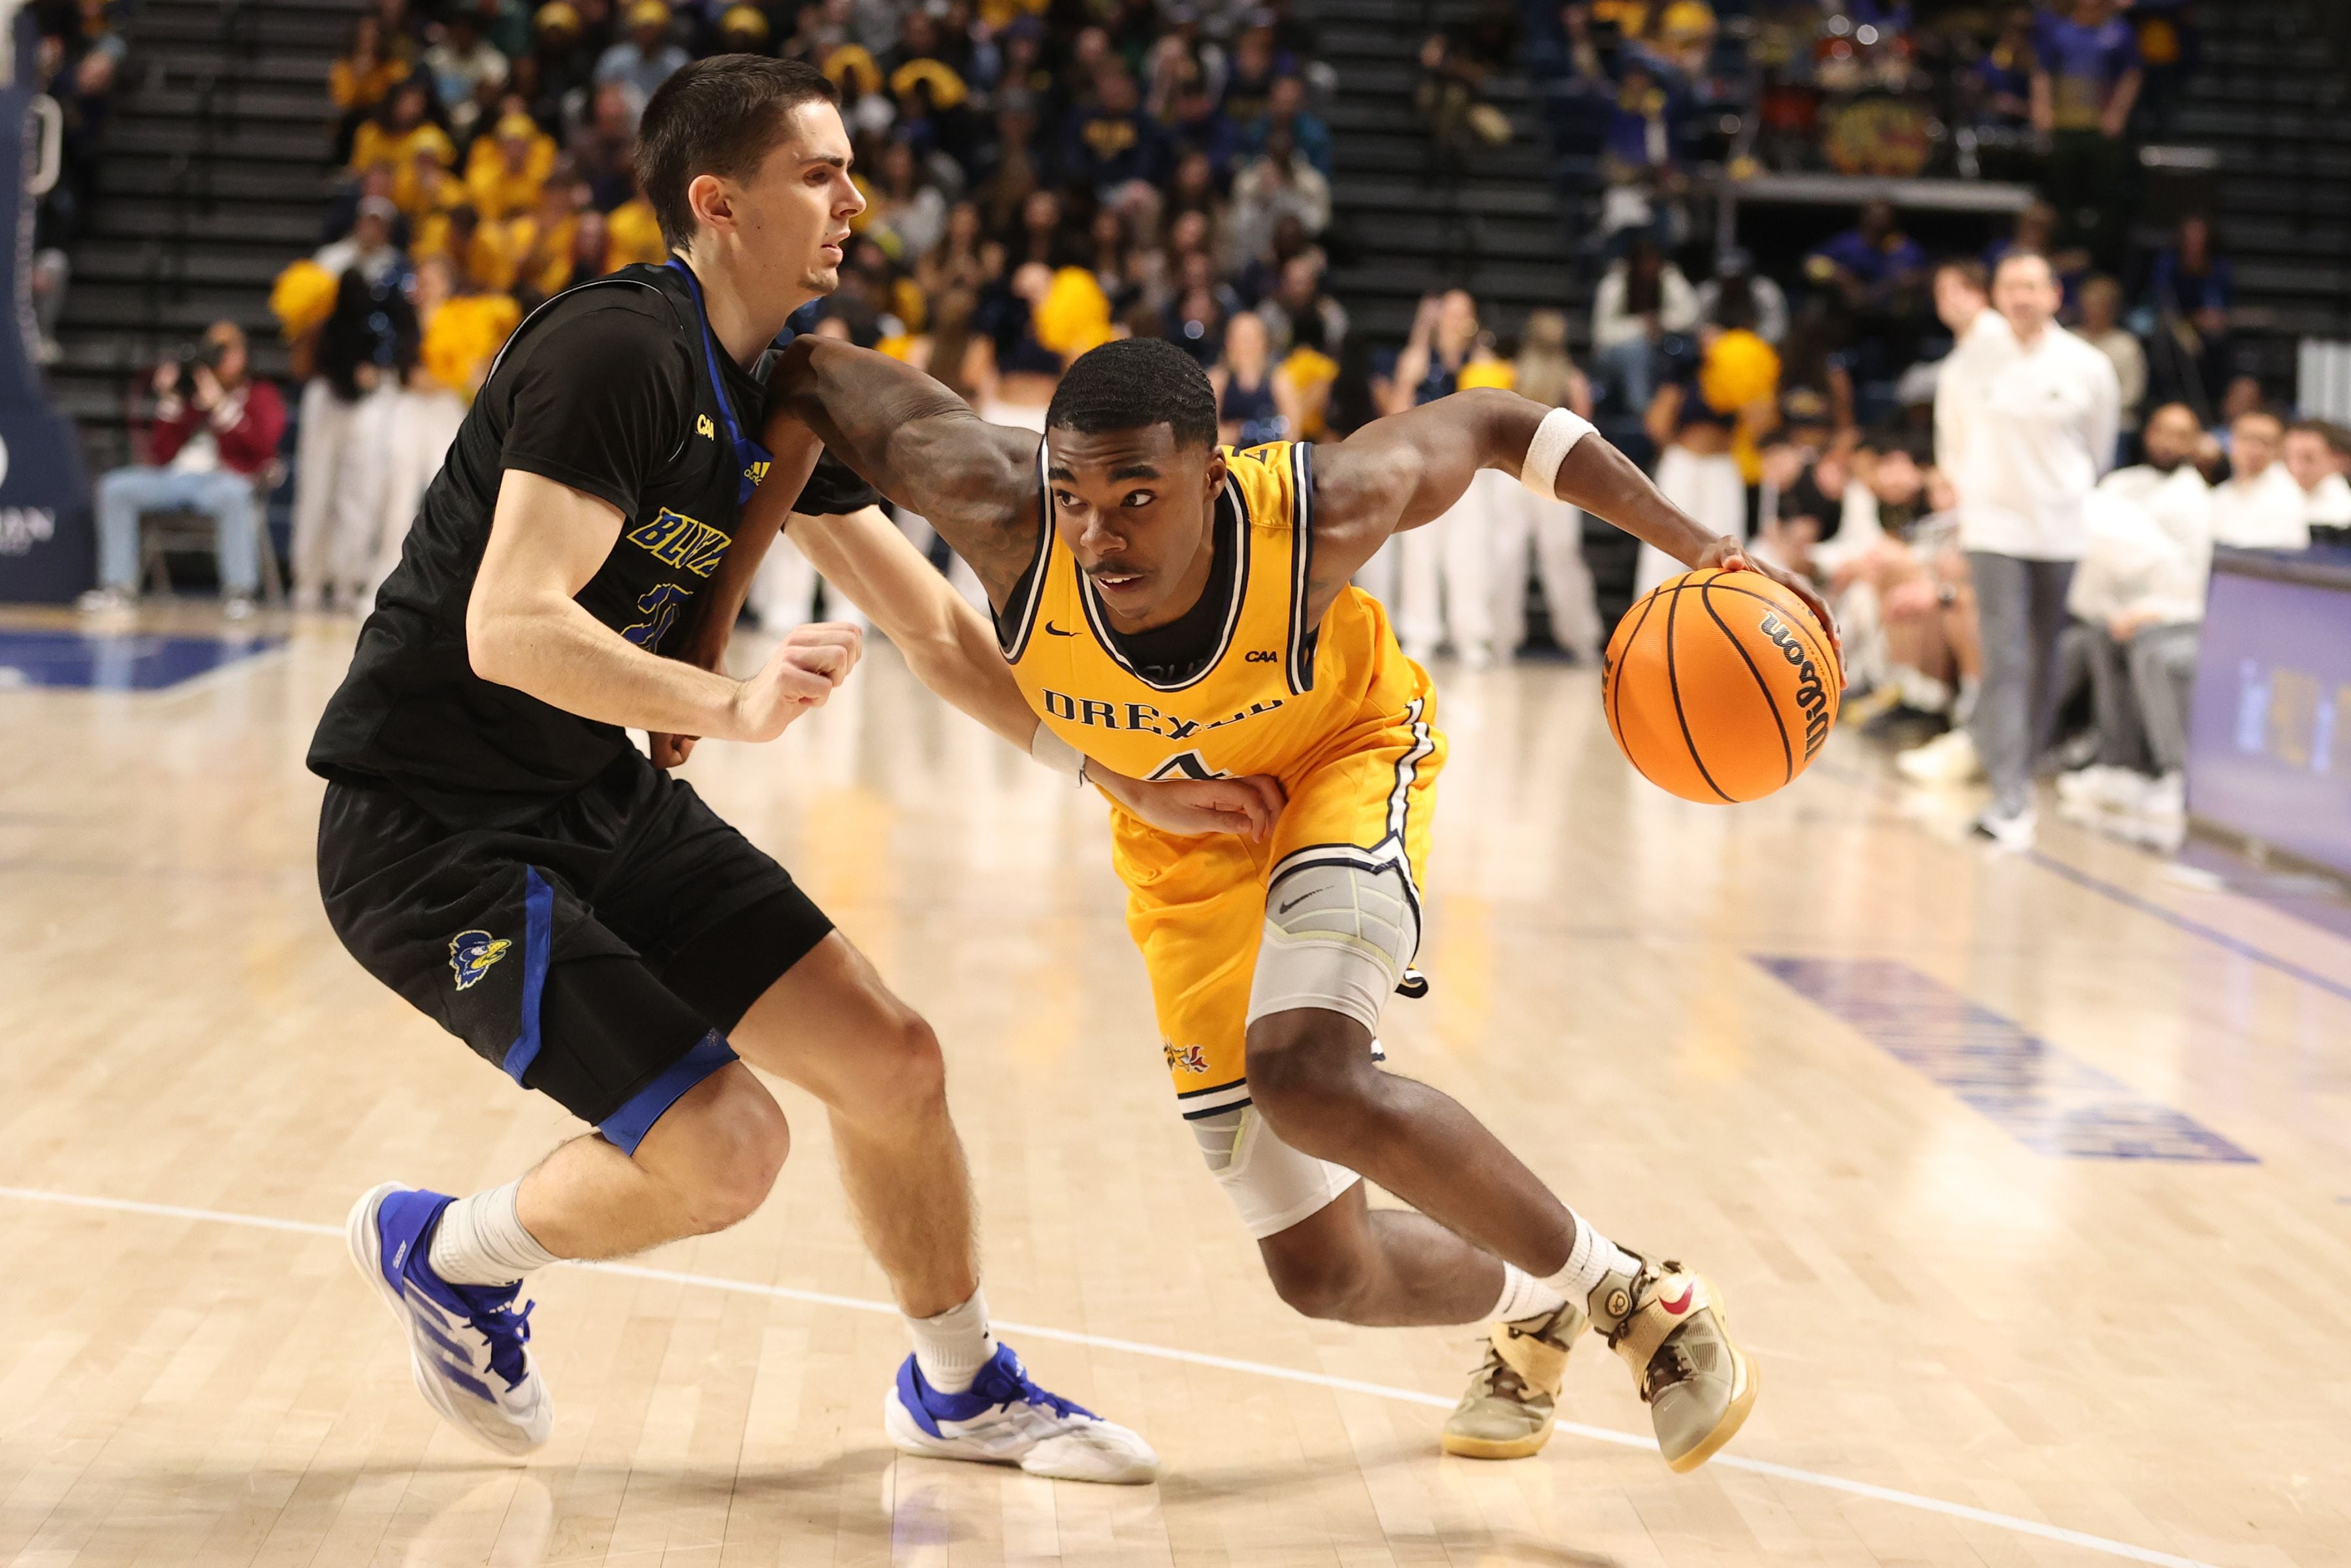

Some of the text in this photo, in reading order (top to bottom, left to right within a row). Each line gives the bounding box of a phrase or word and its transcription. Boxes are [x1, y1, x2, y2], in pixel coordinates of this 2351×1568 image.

[696, 413, 714, 441] CAA
[1244, 650, 1278, 663] CAA
[1759, 610, 1831, 764] Wilson
